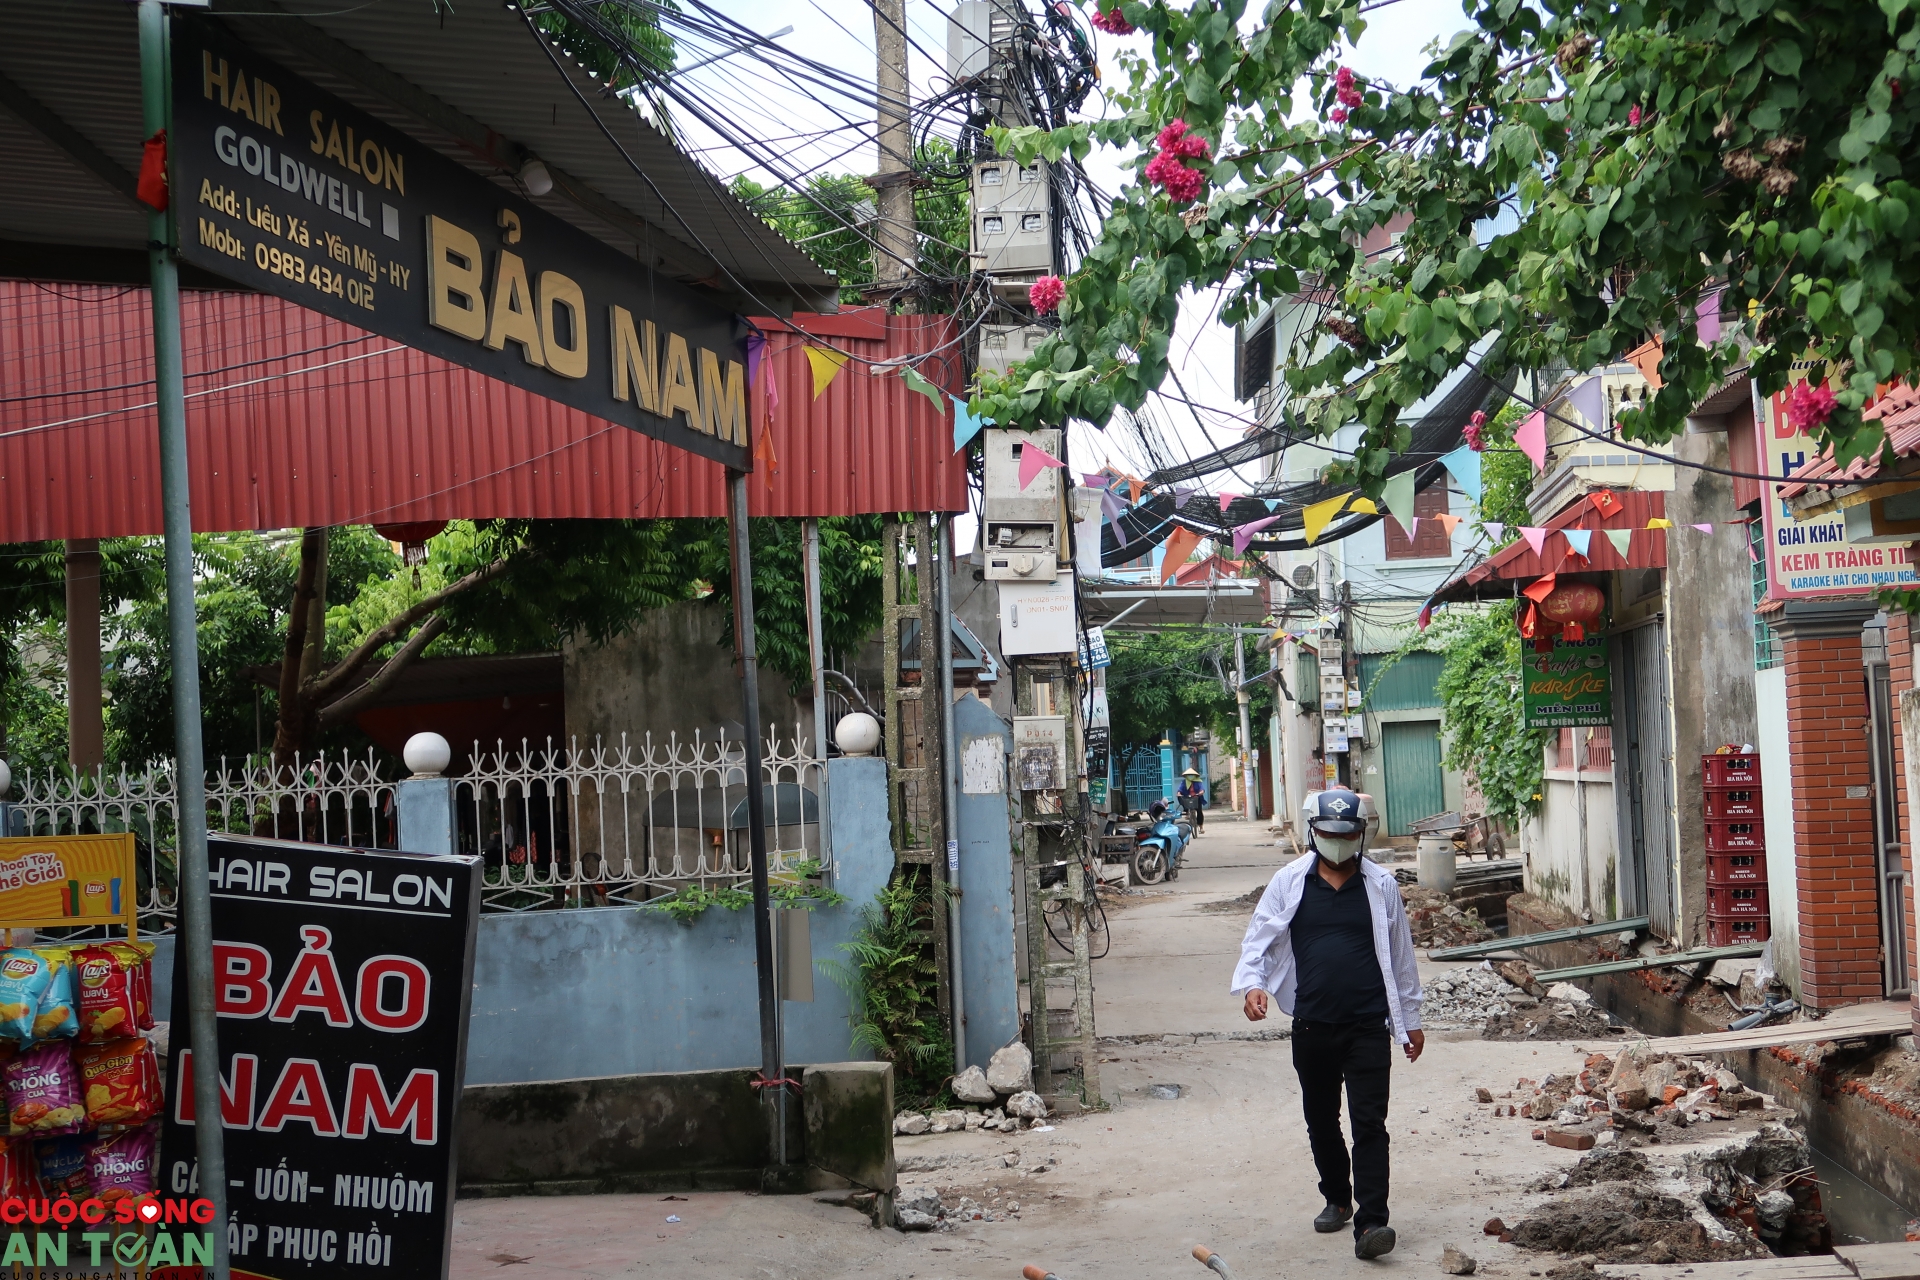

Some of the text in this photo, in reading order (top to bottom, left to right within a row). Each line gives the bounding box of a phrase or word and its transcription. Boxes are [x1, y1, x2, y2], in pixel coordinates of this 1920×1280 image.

[203, 50, 404, 197] HAIR SALON
[214, 125, 372, 228] GOLDWELL
[198, 178, 241, 220] Add:
[286, 214, 310, 248] Xá
[324, 231, 351, 266] Yên
[354, 245, 378, 283] Mỹ
[389, 260, 411, 291] HY
[255, 243, 305, 285] 0983
[309, 264, 344, 299] 434
[347, 278, 375, 311] 012
[425, 208, 748, 448] BẢO NAM
[1778, 519, 1844, 546] GIẢI KHÁT
[1782, 553, 1820, 573] KEM
[1825, 547, 1883, 569] TRÀNG
[1791, 576, 1830, 590] KARAOKE
[1833, 572, 1849, 586] HÁT
[1849, 573, 1869, 585] CHO
[1872, 571, 1896, 584] NHAU
[1523, 652, 1582, 677] Café
[1528, 672, 1606, 701] KARAOKE
[1576, 702, 1601, 713] PHÍ
[0, 854, 54, 873] hoai Tây
[25, 863, 63, 884] Giới
[86, 883, 106, 895] Lay's
[209, 857, 453, 909] HAIR SALON
[82, 962, 111, 980] Lay's
[212, 924, 432, 1034] BẢO
[83, 987, 109, 999] wavy
[85, 1064, 106, 1079] Que
[107, 1056, 133, 1069] Giòn
[9, 1072, 62, 1092] PHỒNG
[27, 1091, 46, 1099] CUA
[175, 1049, 438, 1146] NAM
[93, 1158, 145, 1178] PHỒNG
[113, 1175, 132, 1184] CUA
[334, 1172, 434, 1218] NHUỘM
[227, 1210, 392, 1268] ẤP PHỤC HỒI
